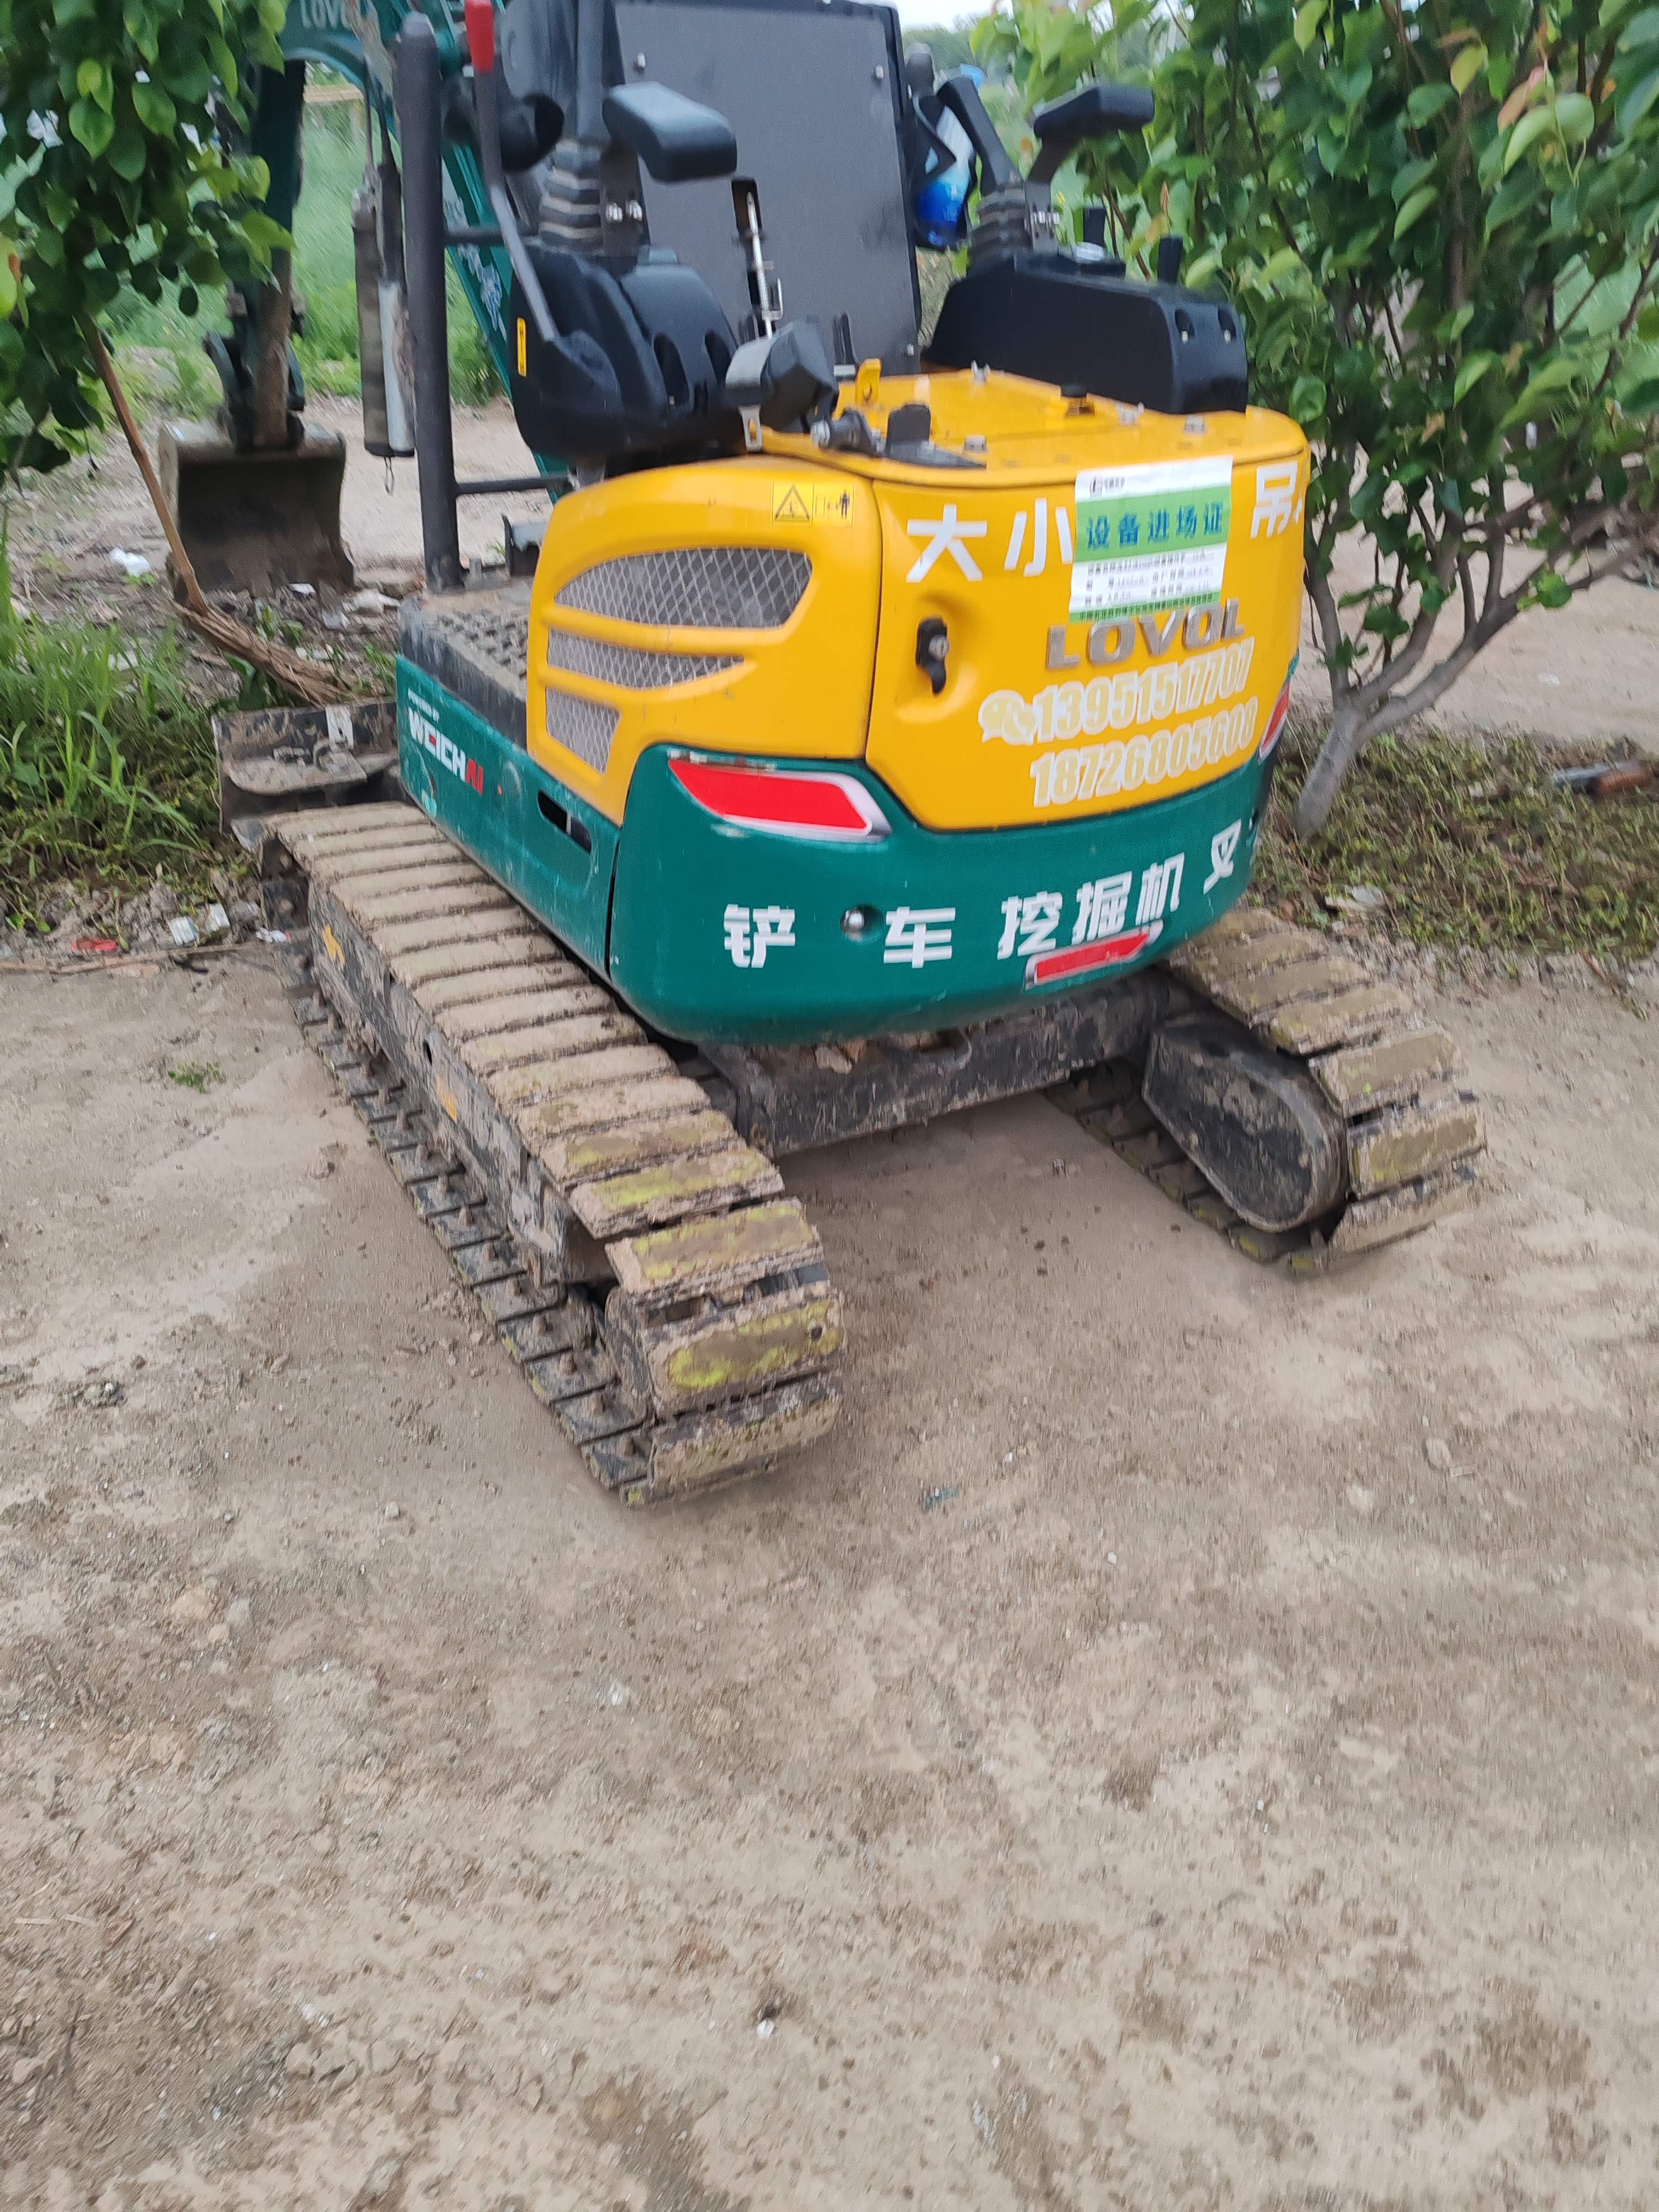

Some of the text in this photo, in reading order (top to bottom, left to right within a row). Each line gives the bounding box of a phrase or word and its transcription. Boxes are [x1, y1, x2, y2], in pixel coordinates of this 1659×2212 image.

[1086, 501, 1224, 550] 设备进场证
[1250, 461, 1303, 539] 吊
[1046, 597, 1245, 671] LOVOL
[1033, 637, 1255, 742] 13951517707
[408, 706, 484, 795] WEICHAI
[1030, 696, 1258, 808] 18726805608
[997, 853, 1185, 959] 挖掘机
[1203, 816, 1252, 895] 叉
